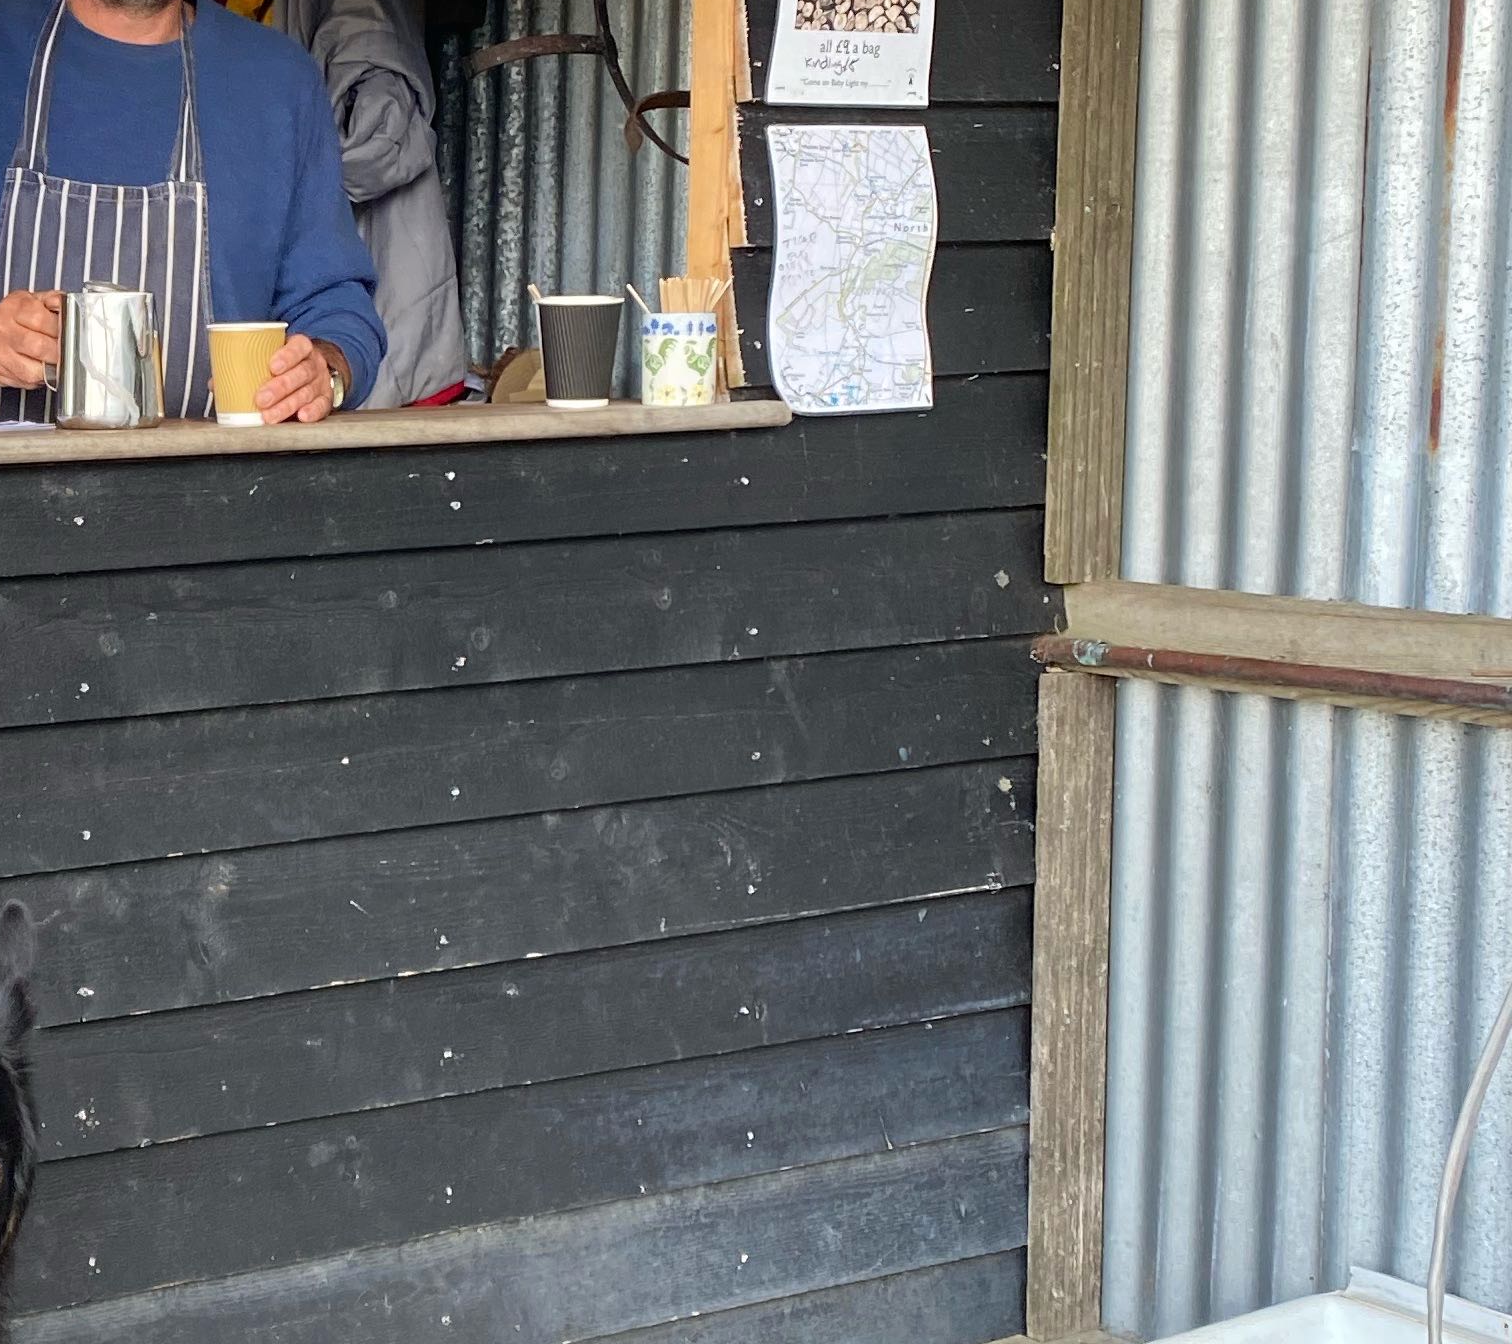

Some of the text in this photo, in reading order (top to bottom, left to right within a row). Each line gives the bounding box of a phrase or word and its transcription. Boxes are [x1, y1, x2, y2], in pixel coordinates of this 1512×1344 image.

[820, 40, 832, 52] all
[852, 44, 858, 53] a
[862, 40, 880, 58] bag
